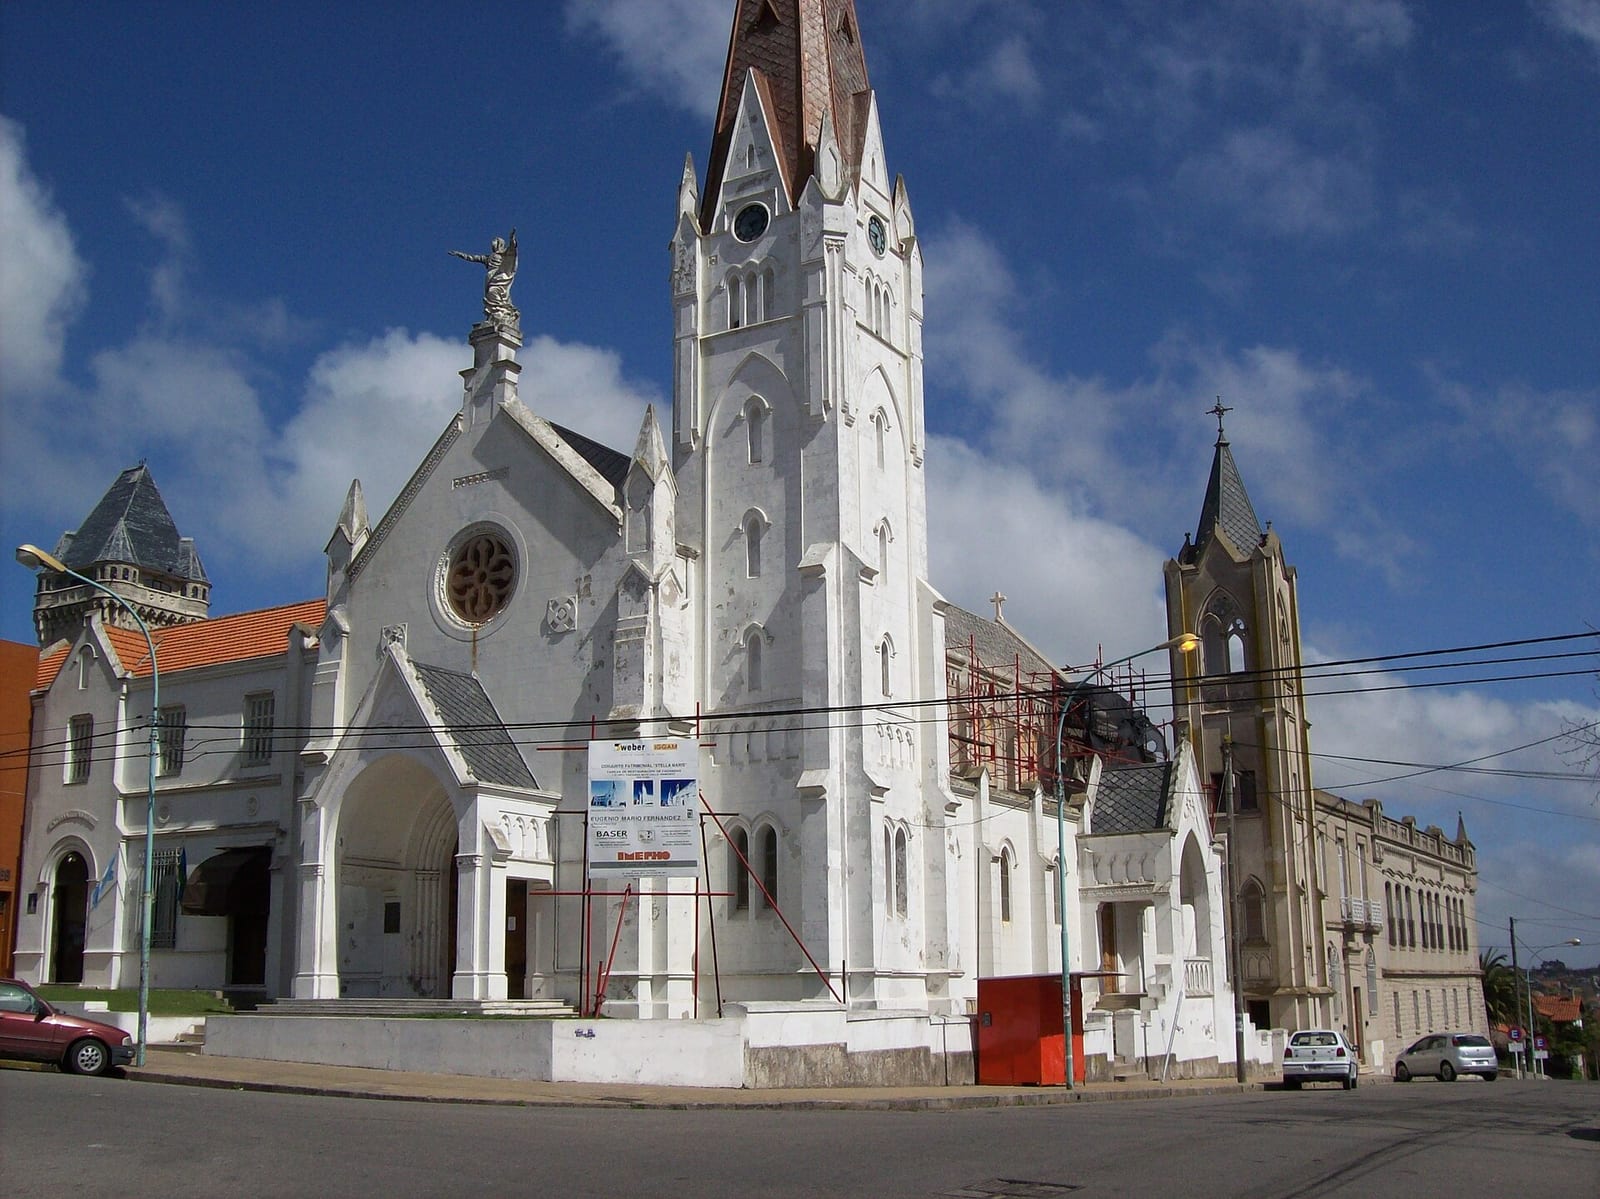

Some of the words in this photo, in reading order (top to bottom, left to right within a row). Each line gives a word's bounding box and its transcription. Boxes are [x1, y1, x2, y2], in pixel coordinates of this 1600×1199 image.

[620, 743, 646, 751] weber
[596, 830, 628, 838] BASER
[1511, 1030, 1519, 1038] E
[1537, 1038, 1544, 1047] E
